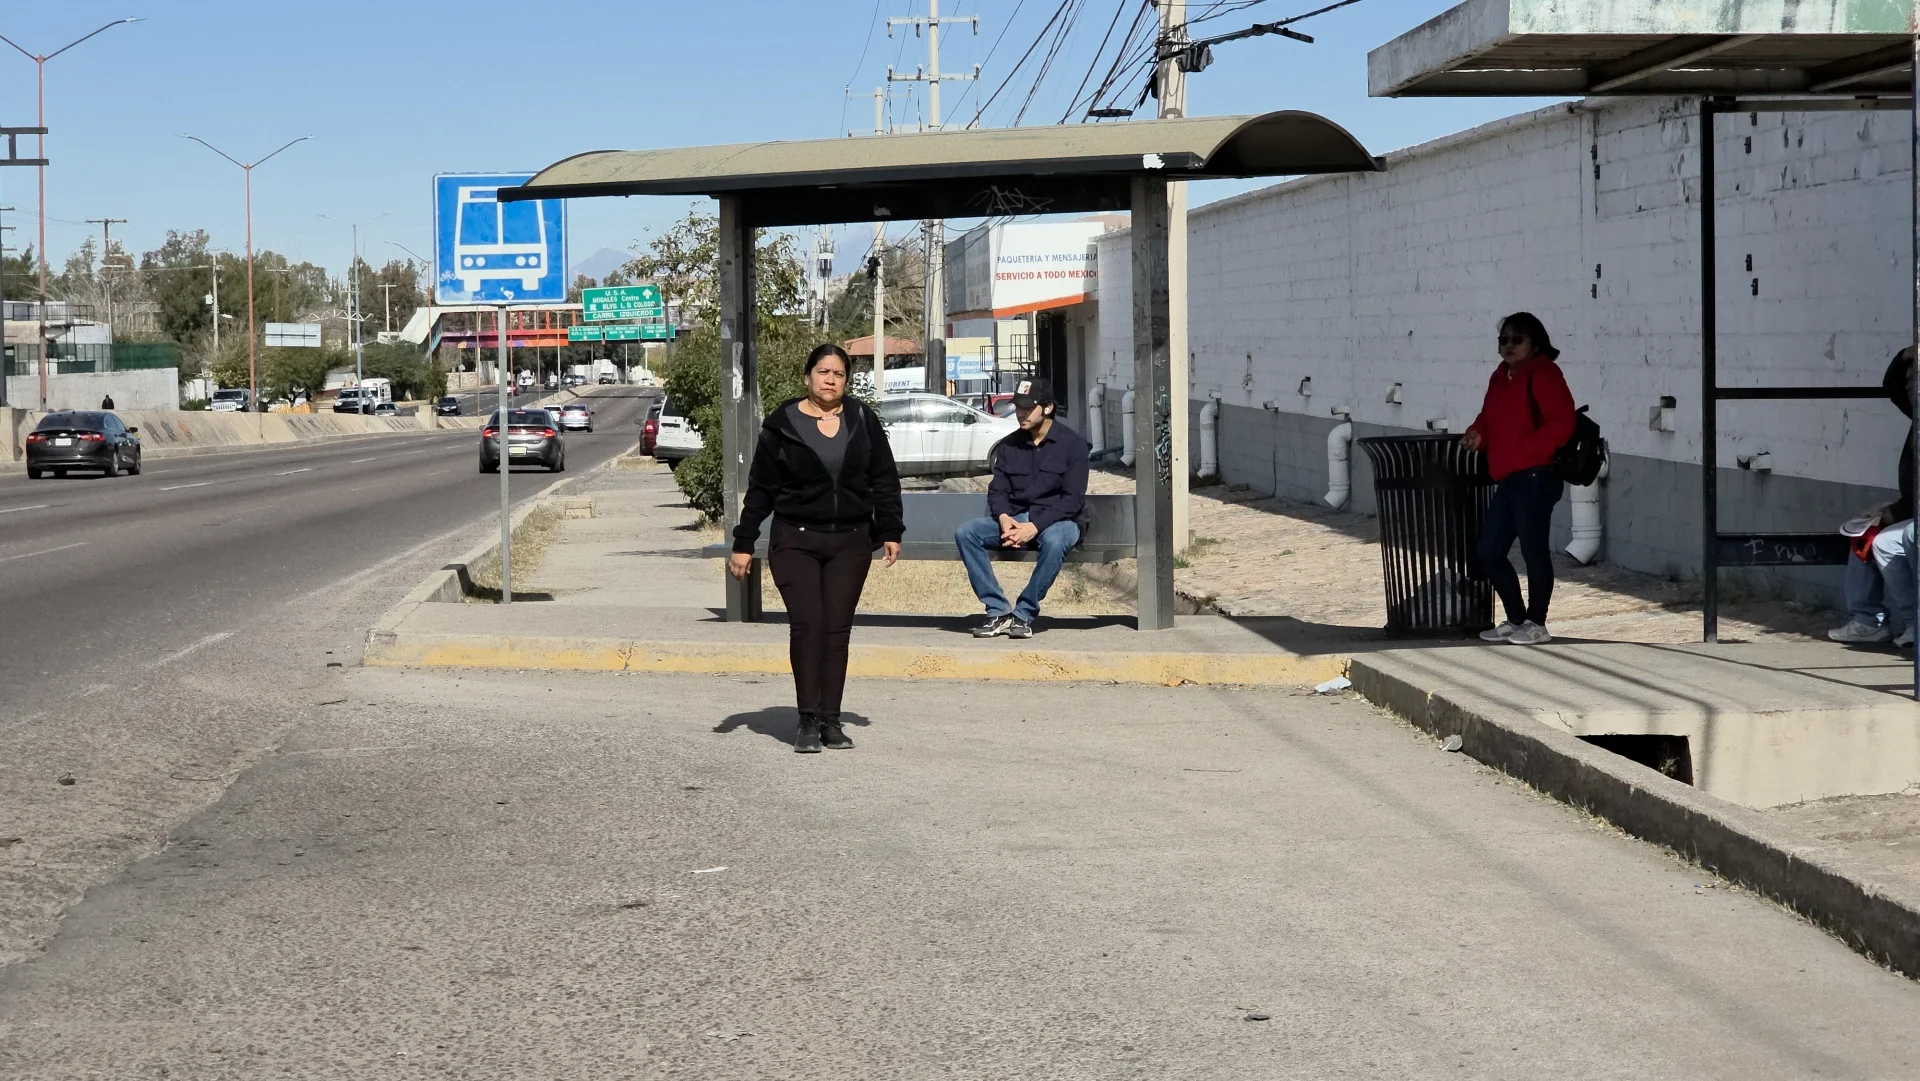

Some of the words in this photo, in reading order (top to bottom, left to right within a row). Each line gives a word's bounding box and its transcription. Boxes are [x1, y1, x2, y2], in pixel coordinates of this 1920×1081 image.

[997, 255, 1043, 264] PAQUETERIA
[1044, 254, 1050, 262] Y
[1052, 253, 1097, 262] MENSAJERIA
[995, 272, 1035, 281] SERVICIO
[1036, 271, 1042, 280] A
[1044, 270, 1066, 279] TODO
[884, 380, 911, 389] TORENT
